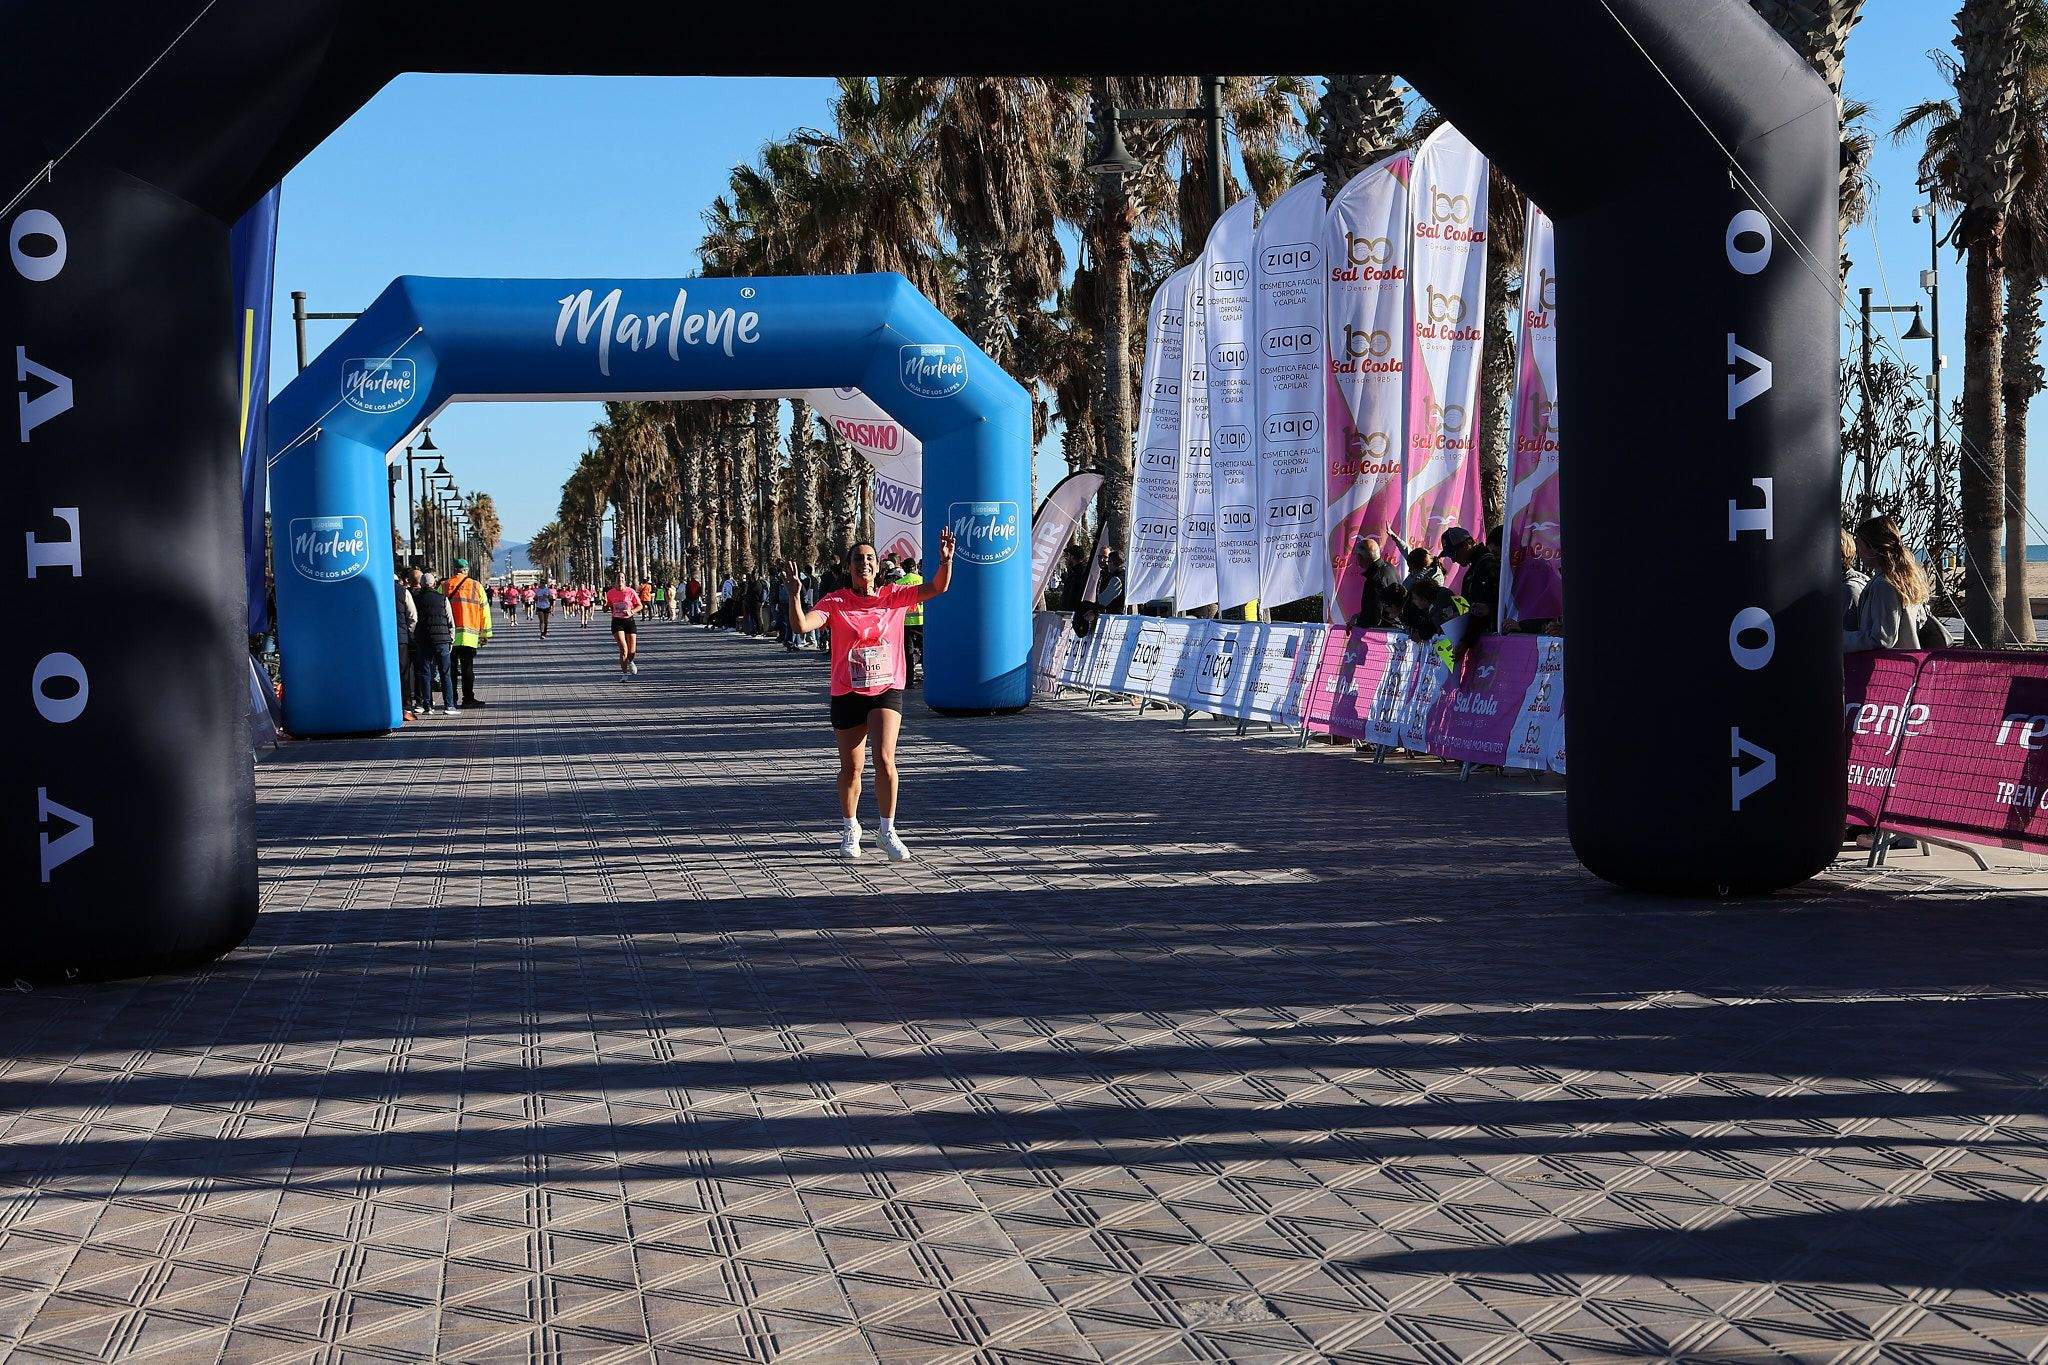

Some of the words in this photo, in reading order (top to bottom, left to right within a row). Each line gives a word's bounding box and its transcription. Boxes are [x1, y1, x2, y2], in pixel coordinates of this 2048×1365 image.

[1415, 222, 1440, 239] Sal
[1444, 225, 1486, 243] Costa
[1267, 250, 1311, 268] ziaja
[1214, 269, 1244, 286] ziaja
[1331, 267, 1359, 282] Sal
[1364, 265, 1405, 281] Costa
[1272, 288, 1308, 298] CORPORAL
[1278, 297, 1307, 306] CAPILAR
[1527, 311, 1549, 329] Sal
[1415, 323, 1437, 338] Sal
[1440, 325, 1481, 341] Costa
[1269, 333, 1312, 351] ziaja
[1331, 360, 1357, 374] Sal
[1362, 358, 1403, 373] Costa
[1272, 373, 1309, 382] CORPORAL
[1278, 381, 1308, 390] CAPILAR
[943, 382, 961, 394] ALPES
[364, 403, 374, 411] DE
[387, 397, 406, 410] ALPES
[836, 418, 898, 451] COSMO
[1269, 419, 1312, 437] ziaja
[1220, 433, 1246, 449] ziaja
[1147, 454, 1178, 470] ziaj
[1272, 458, 1309, 467] CORPORAL
[1332, 461, 1357, 476] Sal
[1360, 460, 1401, 475] Costa
[1279, 466, 1308, 475] CAPILAR
[1137, 476, 1171, 485] COSMÉTICA
[1270, 502, 1313, 521] ziaja
[1725, 207, 1779, 813] VOLVO
[1223, 513, 1251, 529] ziaja
[9, 208, 96, 885] VOLVO
[981, 553, 994, 561] LOS
[995, 547, 1012, 560] ALPES
[1275, 541, 1311, 551] CORPORAL
[1281, 550, 1311, 559] CAPILAR
[315, 570, 325, 579] DE
[326, 571, 340, 579] LOS
[341, 562, 361, 577] ALPES
[1132, 643, 1161, 674] ziaja
[1202, 654, 1233, 689] ziaja
[1453, 692, 1473, 713] Sal
[1472, 692, 1499, 716] Costa
[1995, 781, 2038, 808] TREN
